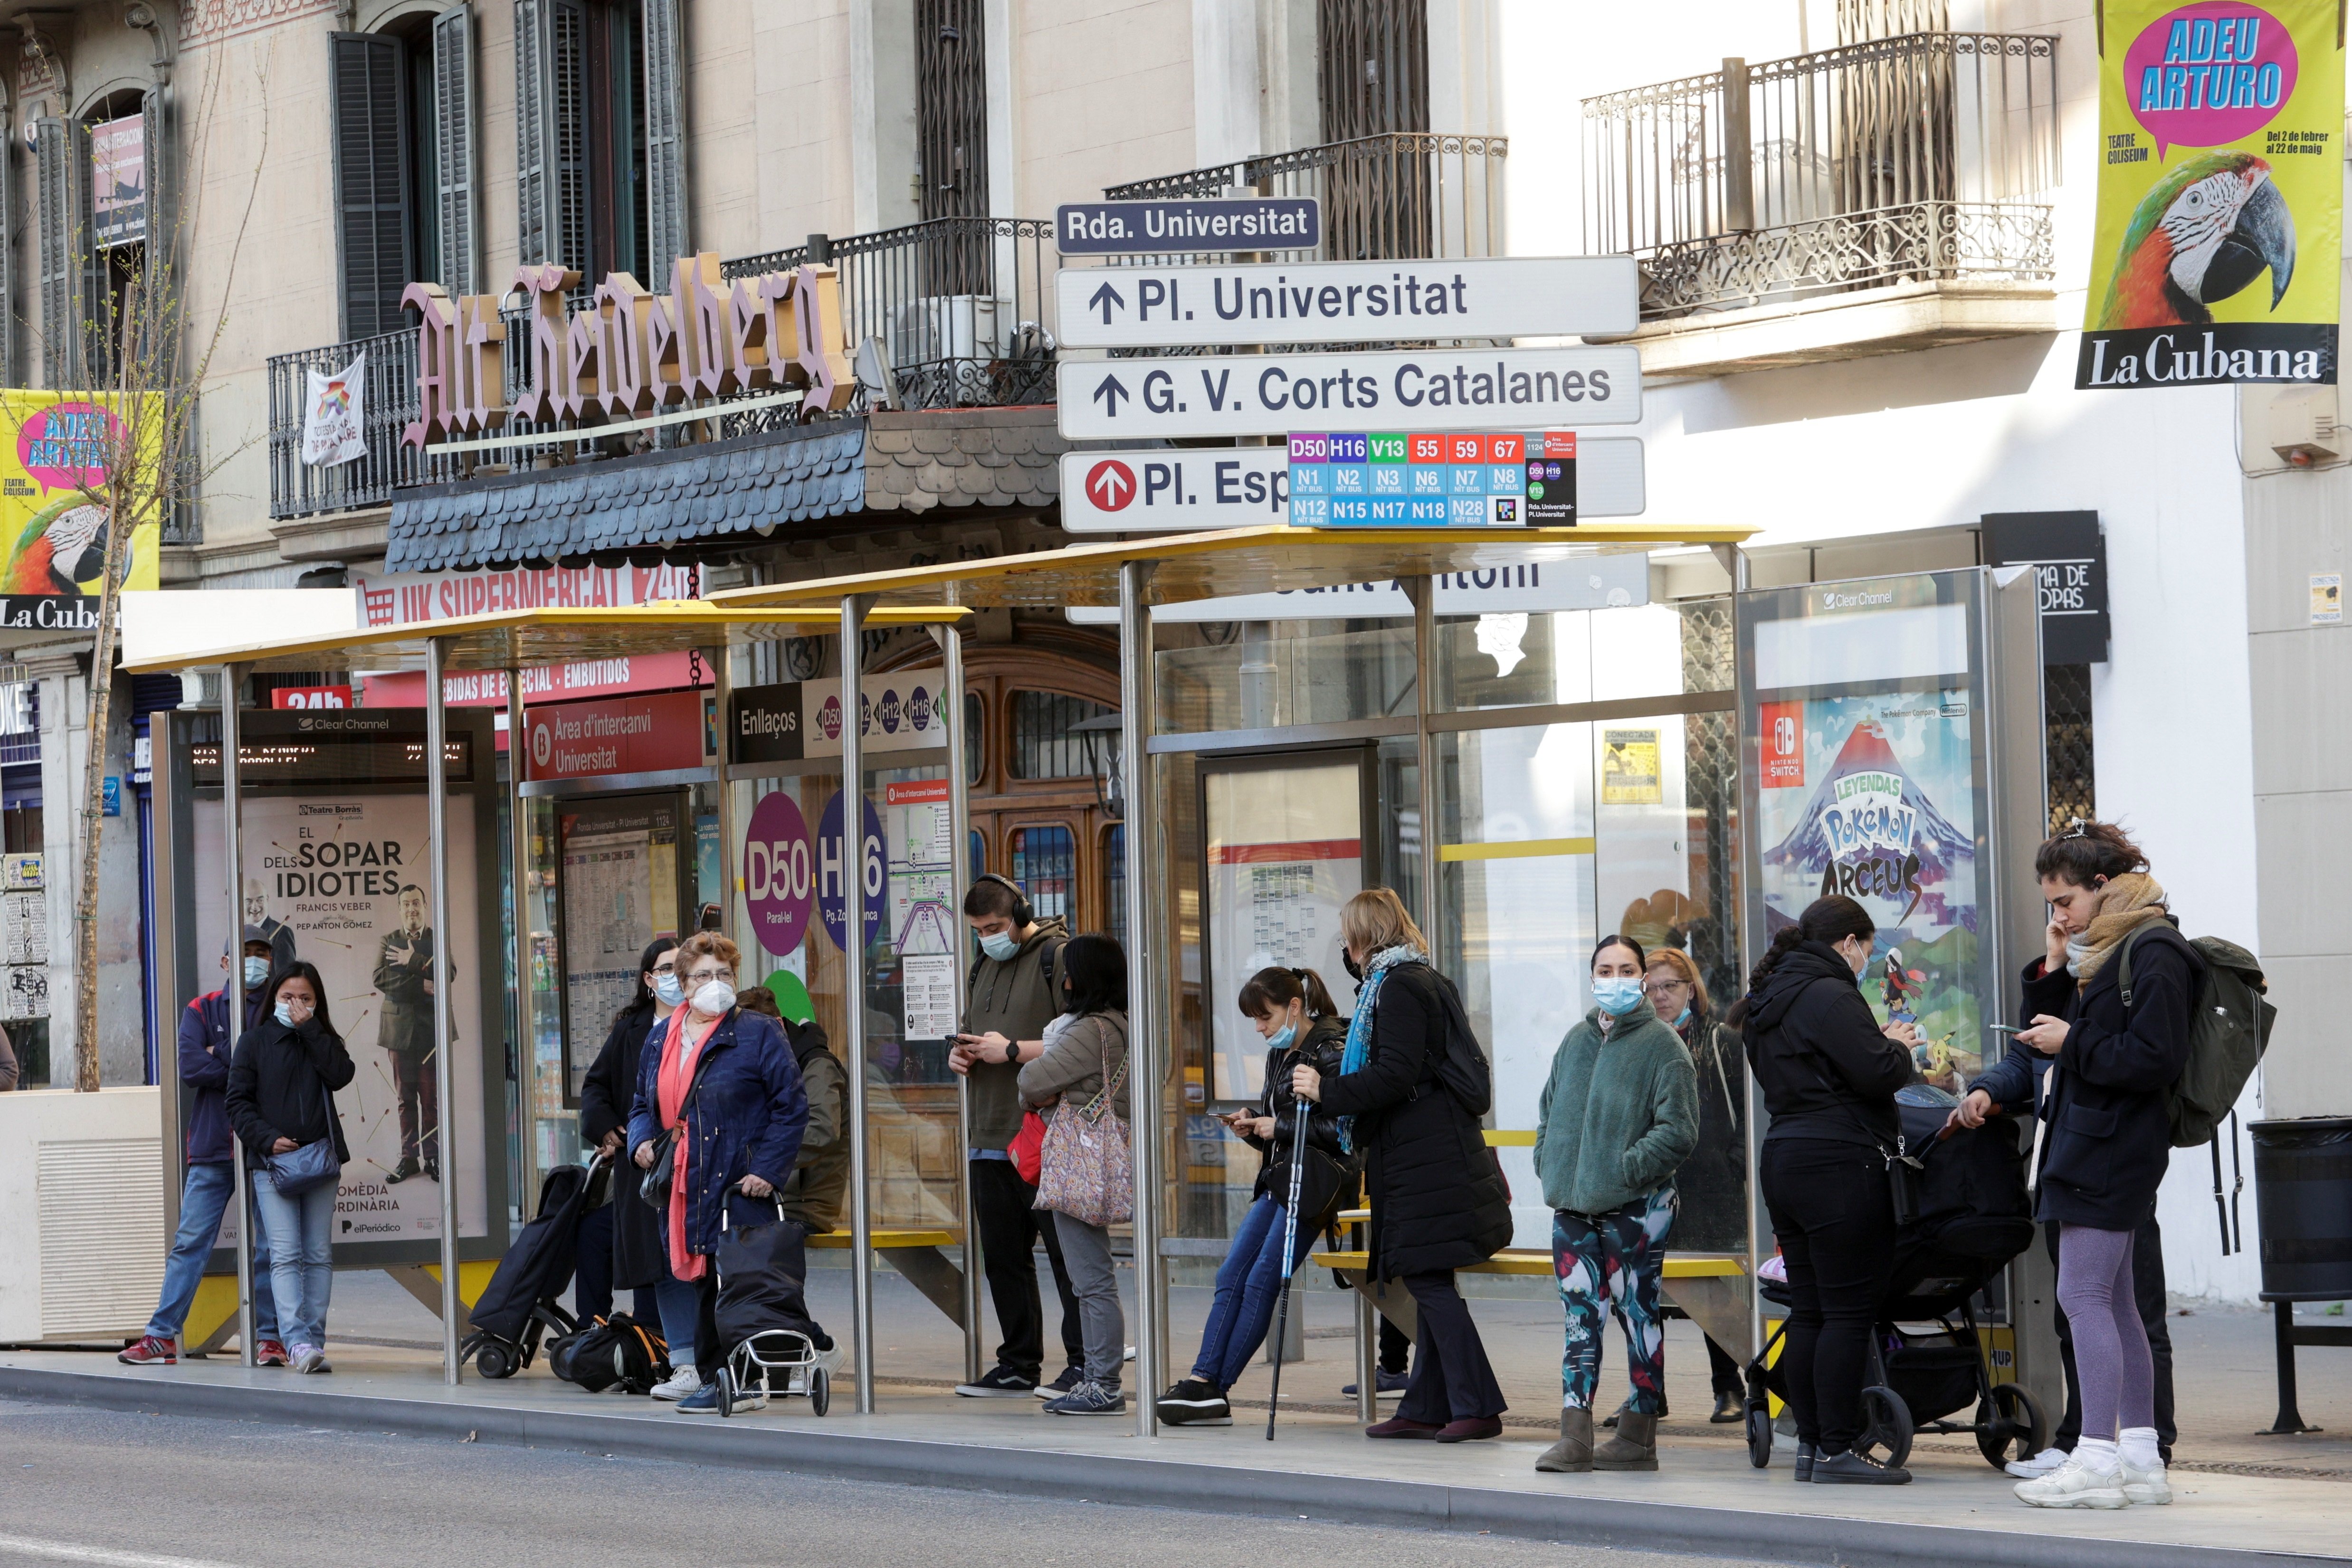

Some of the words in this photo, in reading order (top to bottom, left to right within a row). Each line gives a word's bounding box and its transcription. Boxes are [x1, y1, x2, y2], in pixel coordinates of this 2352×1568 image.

[2164, 18, 2260, 64] ADEU
[2140, 63, 2282, 112] ARTURO
[2108, 133, 2135, 149] TEATRE
[2267, 131, 2280, 142] Del
[2282, 131, 2287, 141] 2
[2289, 132, 2299, 141] de
[2301, 131, 2329, 142] febrer
[2108, 148, 2148, 165] COLISEUM
[2266, 143, 2274, 153] al
[2276, 143, 2286, 153] 22
[2287, 143, 2297, 153] de
[2299, 143, 2322, 156] maig
[1067, 213, 1133, 239] Rda.
[1146, 208, 1307, 237] Universitat
[1140, 278, 1193, 321] Pl.
[1214, 274, 1467, 321] Universitat
[2088, 340, 2139, 386] La
[2145, 332, 2321, 380] Cubana
[1143, 370, 1186, 414] G.
[1202, 369, 1241, 412] V.
[1258, 367, 1379, 412] Corts
[1396, 361, 1610, 408] Catalanes
[29, 439, 115, 468] ARTUR
[1291, 439, 1326, 457] D50
[1330, 439, 1365, 457] H16
[1371, 440, 1404, 457] V13
[1416, 440, 1438, 457] 55
[1456, 441, 1477, 458] 59
[1495, 441, 1516, 458] 67
[4, 479, 26, 487] TEATRE
[1298, 469, 1318, 485] N1
[1337, 469, 1360, 485] N2
[1377, 470, 1400, 485] N3
[1416, 471, 1438, 486] N6
[1456, 470, 1477, 485] N7
[1494, 468, 1516, 484] N8
[3, 488, 35, 496] COLISEUM
[1145, 464, 1196, 506] Pl.
[1216, 461, 1288, 513] Esp
[1295, 500, 1326, 515] N12
[1333, 503, 1366, 518] N15
[1373, 503, 1405, 518] N17
[1413, 503, 1445, 518] N18
[1453, 500, 1484, 515] N28
[2065, 565, 2089, 586] DE
[402, 583, 432, 624] UK
[439, 566, 617, 617] SUPERMERCAT
[1836, 593, 1858, 608] Clear
[1859, 589, 1892, 605] Channel
[0, 599, 32, 627] La
[37, 599, 122, 628] Cub
[482, 673, 495, 698] DE
[500, 667, 552, 696] ESECIAL
[565, 657, 629, 688] EMBUTIDOS
[287, 689, 344, 709] 24h
[824, 708, 841, 725] D50
[882, 702, 899, 720] H12
[912, 699, 929, 717] H16
[1889, 710, 1911, 718] Pokémon
[1913, 709, 1936, 719] Company
[1942, 706, 1965, 714] Nintendo
[315, 719, 343, 730] Clear
[345, 719, 389, 730] Channel
[555, 712, 581, 740] Àrea
[742, 708, 796, 739] Enllaços
[556, 746, 617, 773] Universitat
[1771, 766, 1799, 777] SWITCH
[896, 789, 905, 798] Àrea
[927, 788, 946, 796] Universitat
[1837, 775, 1900, 800] LEYENDAS
[577, 823, 591, 832] Ronda
[592, 821, 616, 831] Universitat
[625, 817, 648, 827] Universitat
[656, 815, 669, 827] 1124
[299, 827, 314, 838] EL
[265, 857, 297, 868] DELS
[299, 841, 403, 868] SOPAR
[748, 839, 809, 901] D50
[820, 835, 882, 898] H6
[277, 870, 400, 898] IDIOTES
[296, 903, 337, 912] FRANCIS
[340, 903, 371, 911] VEBER
[826, 909, 837, 924] Pg.
[838, 909, 846, 922] Zo
[343, 921, 372, 929] GÓMEZ
[337, 1181, 388, 1196] OMÈDIA
[333, 1197, 400, 1212] RDINÀRIA
[354, 1224, 400, 1233] elPeriódico
